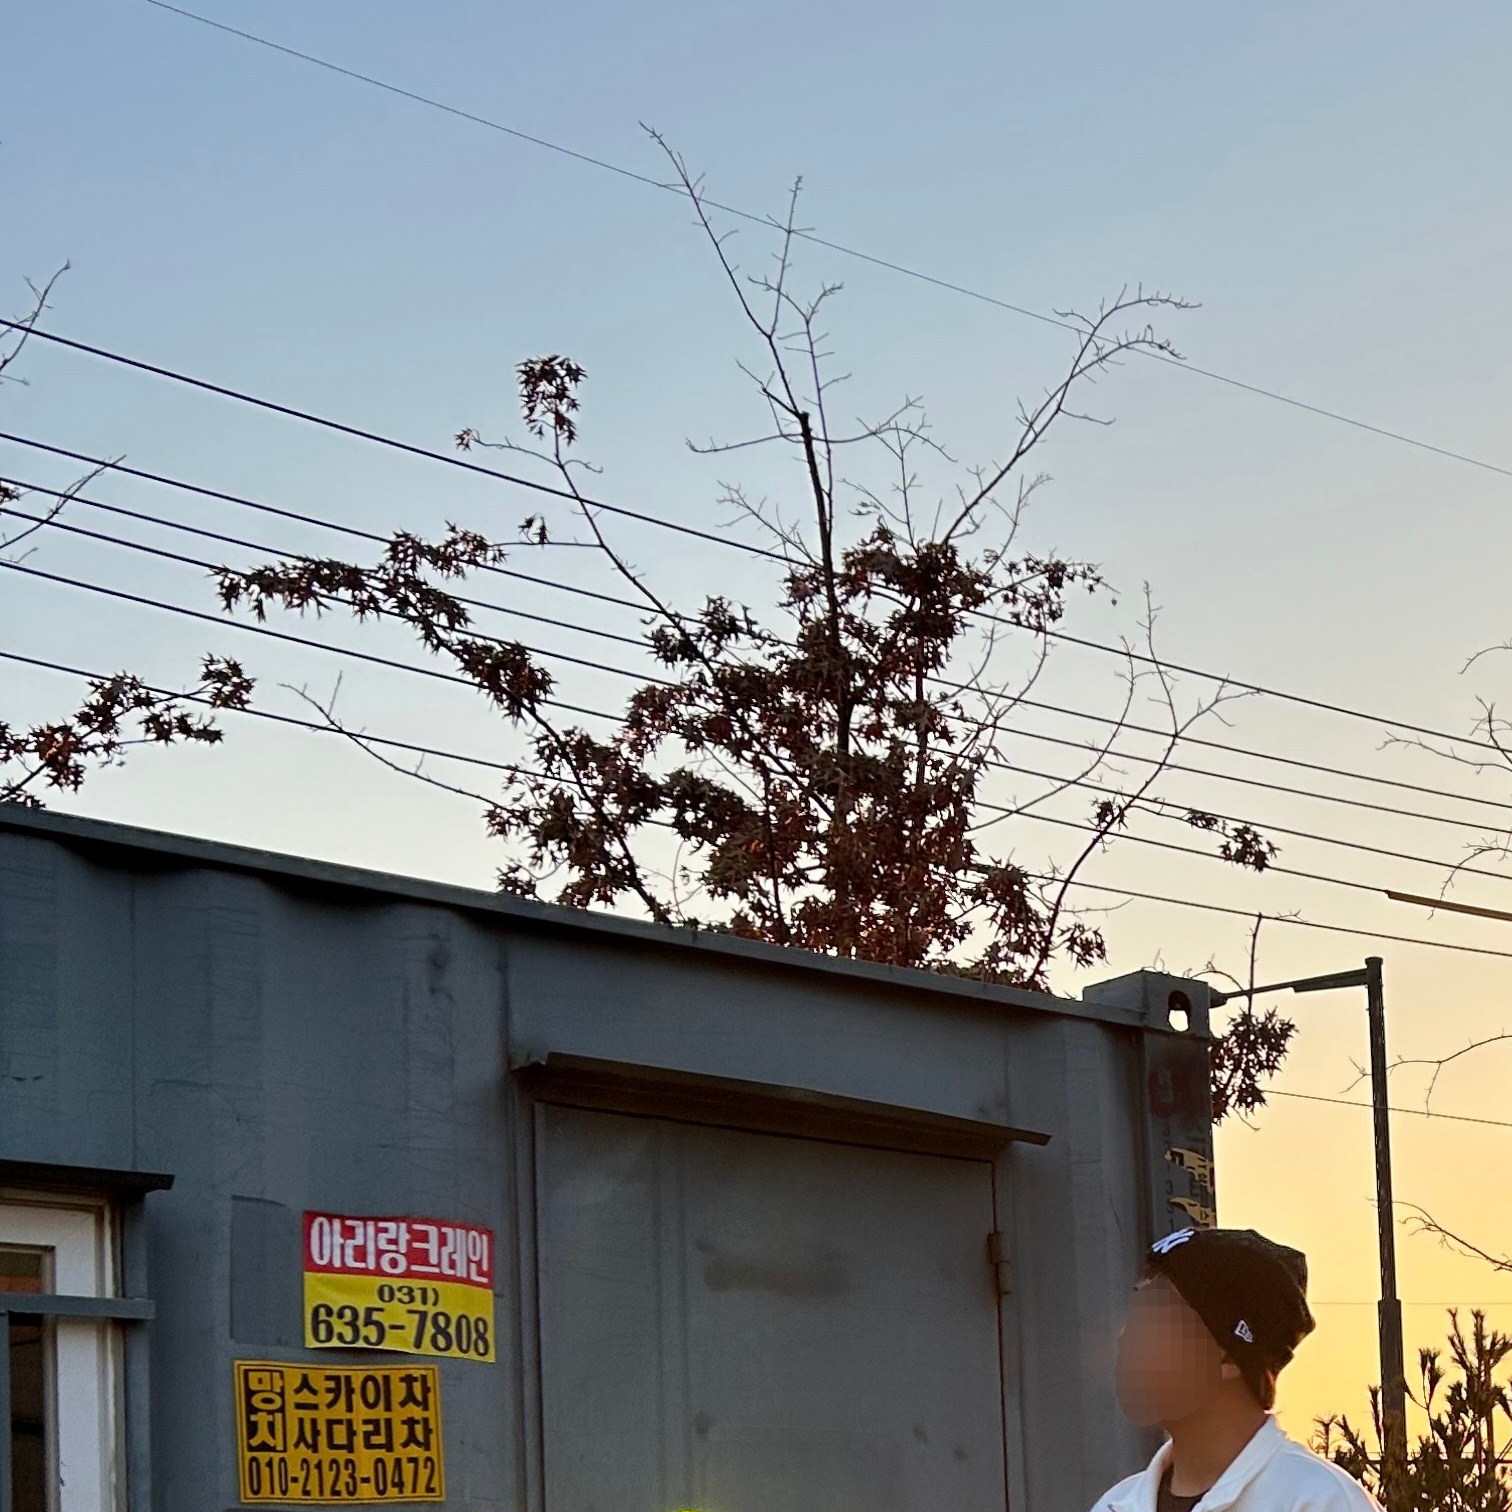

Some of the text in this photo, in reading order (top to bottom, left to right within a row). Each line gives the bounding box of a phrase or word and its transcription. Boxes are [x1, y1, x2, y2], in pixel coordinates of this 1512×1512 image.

[310, 1217, 488, 1282] 아리랑크레인
[377, 1284, 440, 1307] 031)
[311, 1303, 489, 1357] 635-7808
[293, 1373, 431, 1413] 스카이차
[293, 1416, 433, 1454] 사다리차
[248, 1455, 437, 1498] 010-2123-0472
